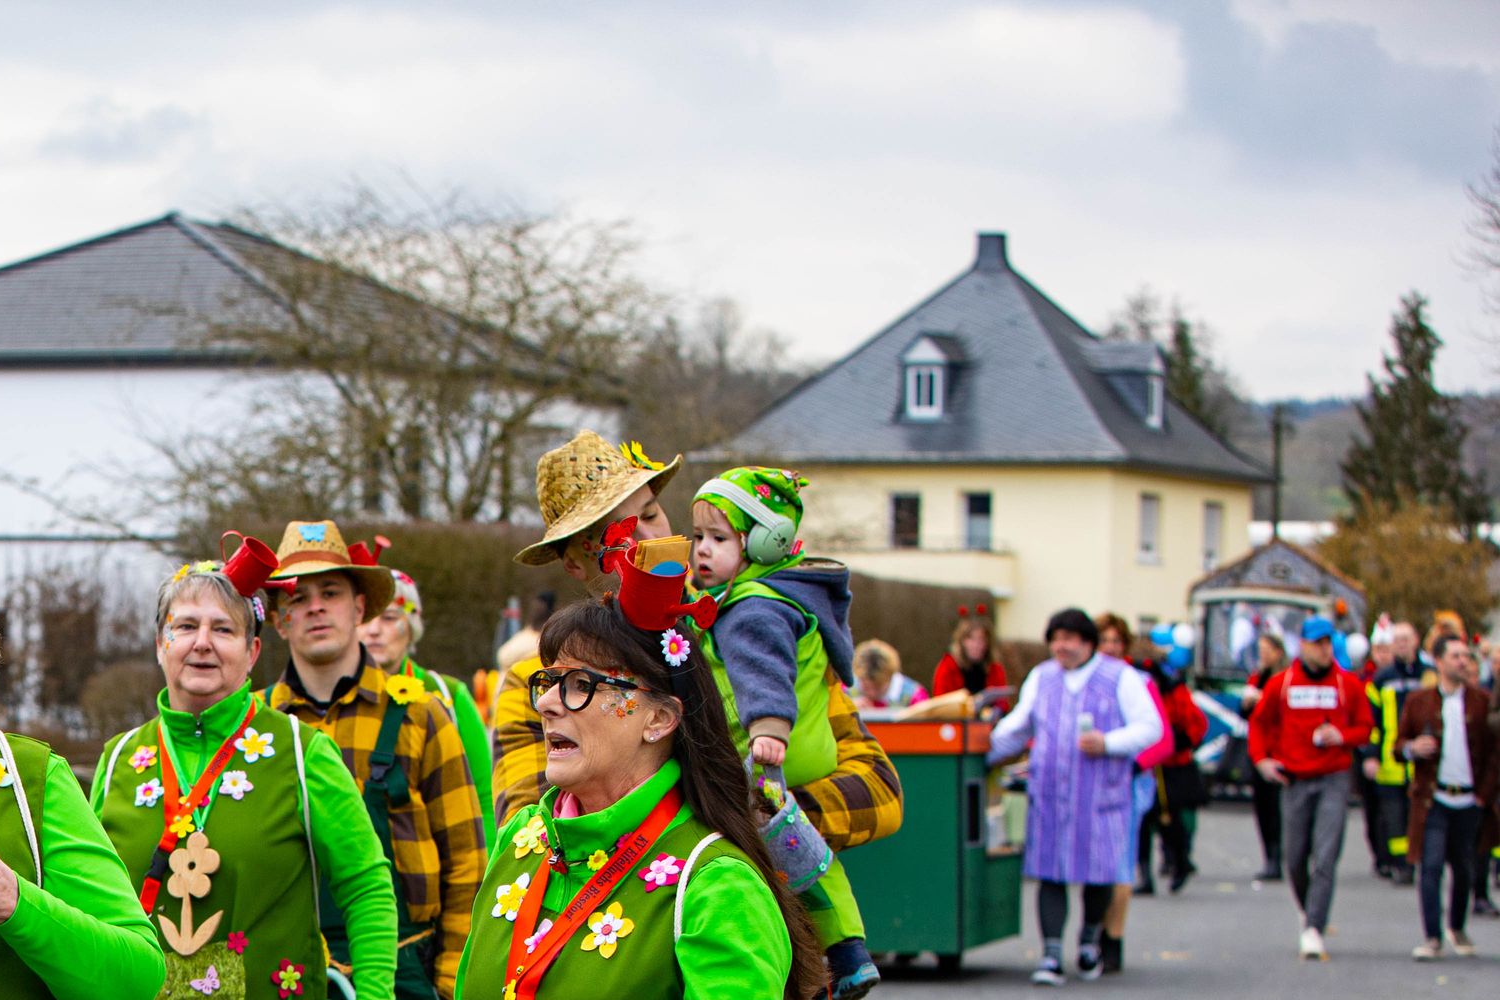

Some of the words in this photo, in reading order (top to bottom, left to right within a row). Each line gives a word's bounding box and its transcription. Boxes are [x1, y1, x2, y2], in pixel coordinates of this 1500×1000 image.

[634, 834, 649, 851] KV
[596, 846, 638, 886] Eifelluchs
[565, 885, 600, 921] Biesdorf
